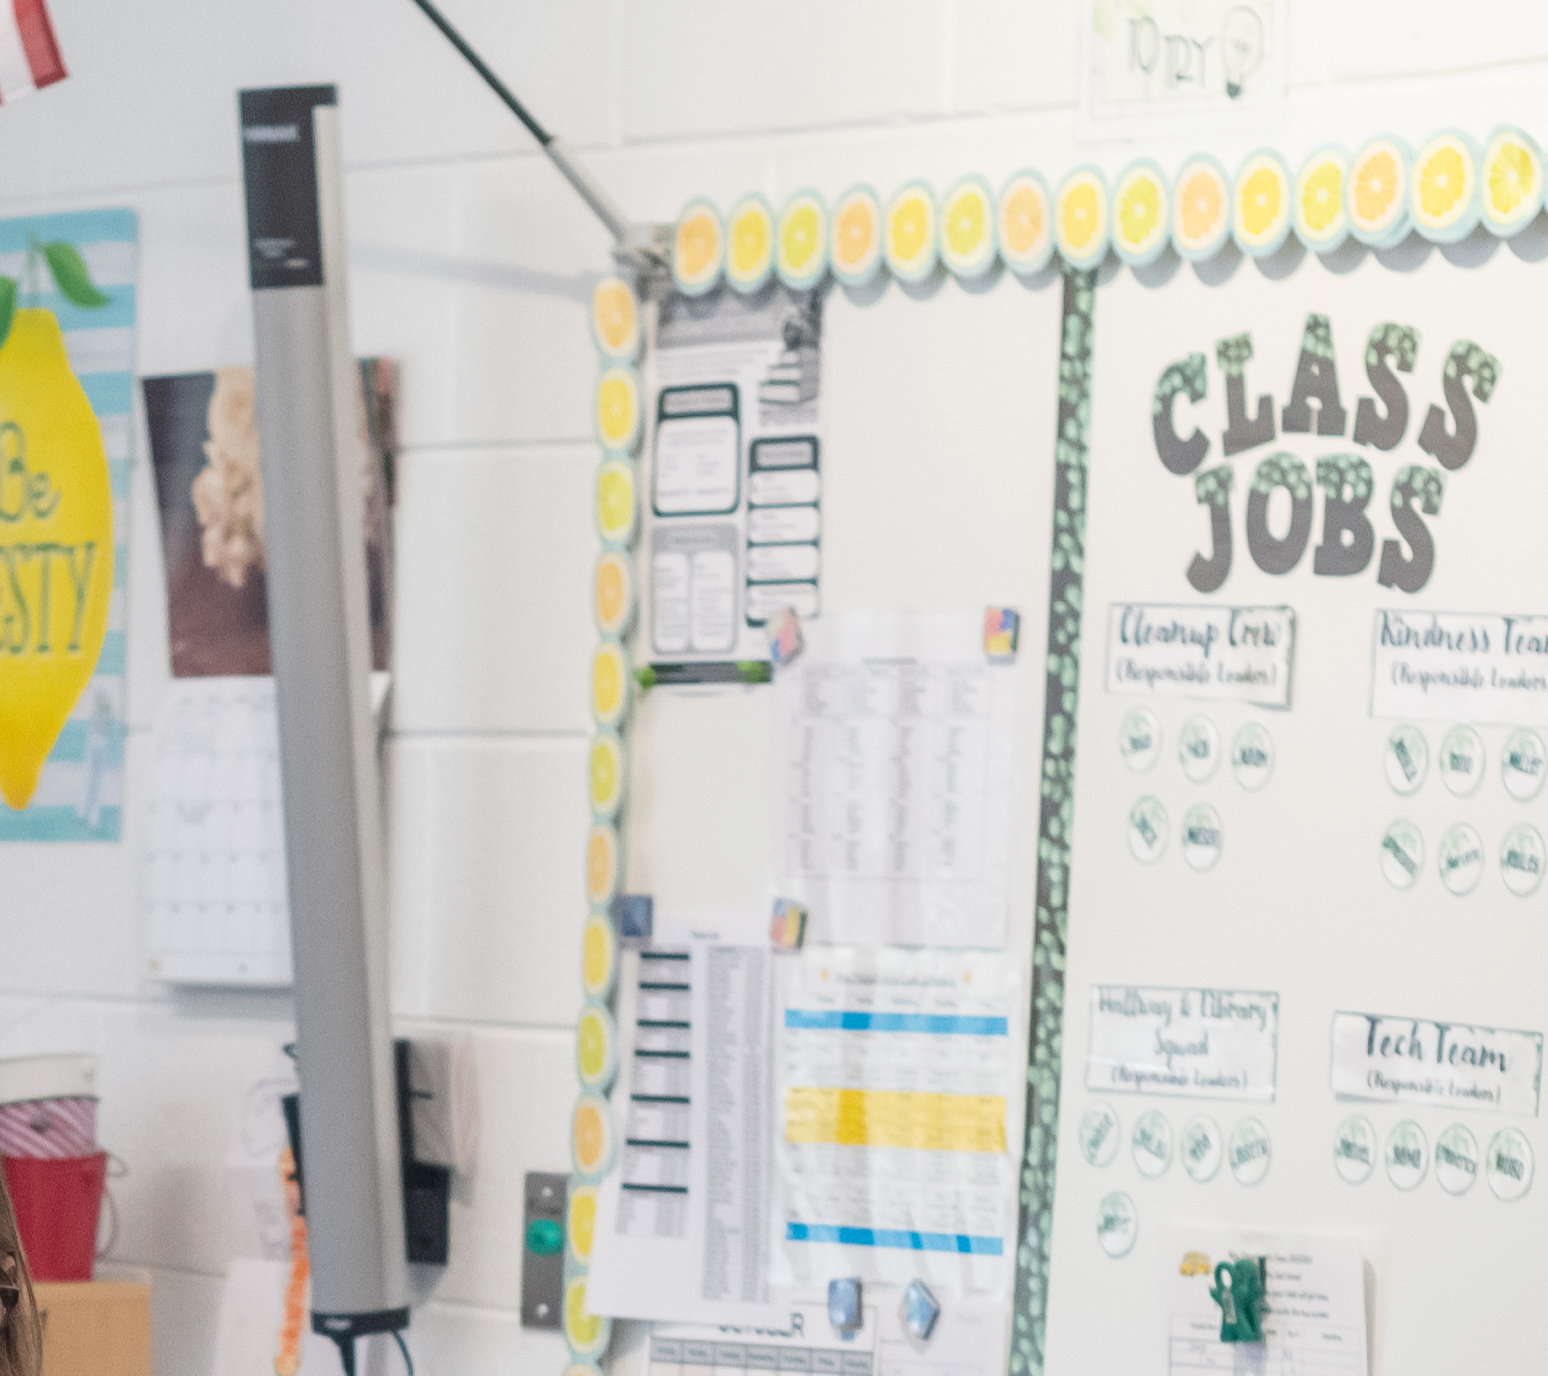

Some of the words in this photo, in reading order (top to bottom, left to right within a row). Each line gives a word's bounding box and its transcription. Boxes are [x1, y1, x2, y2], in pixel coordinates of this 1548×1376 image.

[1152, 313, 1503, 476] CLASS
[1185, 451, 1447, 592] JOBS
[1118, 604, 1219, 660] Cleanup
[1380, 611, 1490, 654] Kindness
[1363, 1014, 1423, 1060] Tech
[1434, 1022, 1512, 1074] Team
